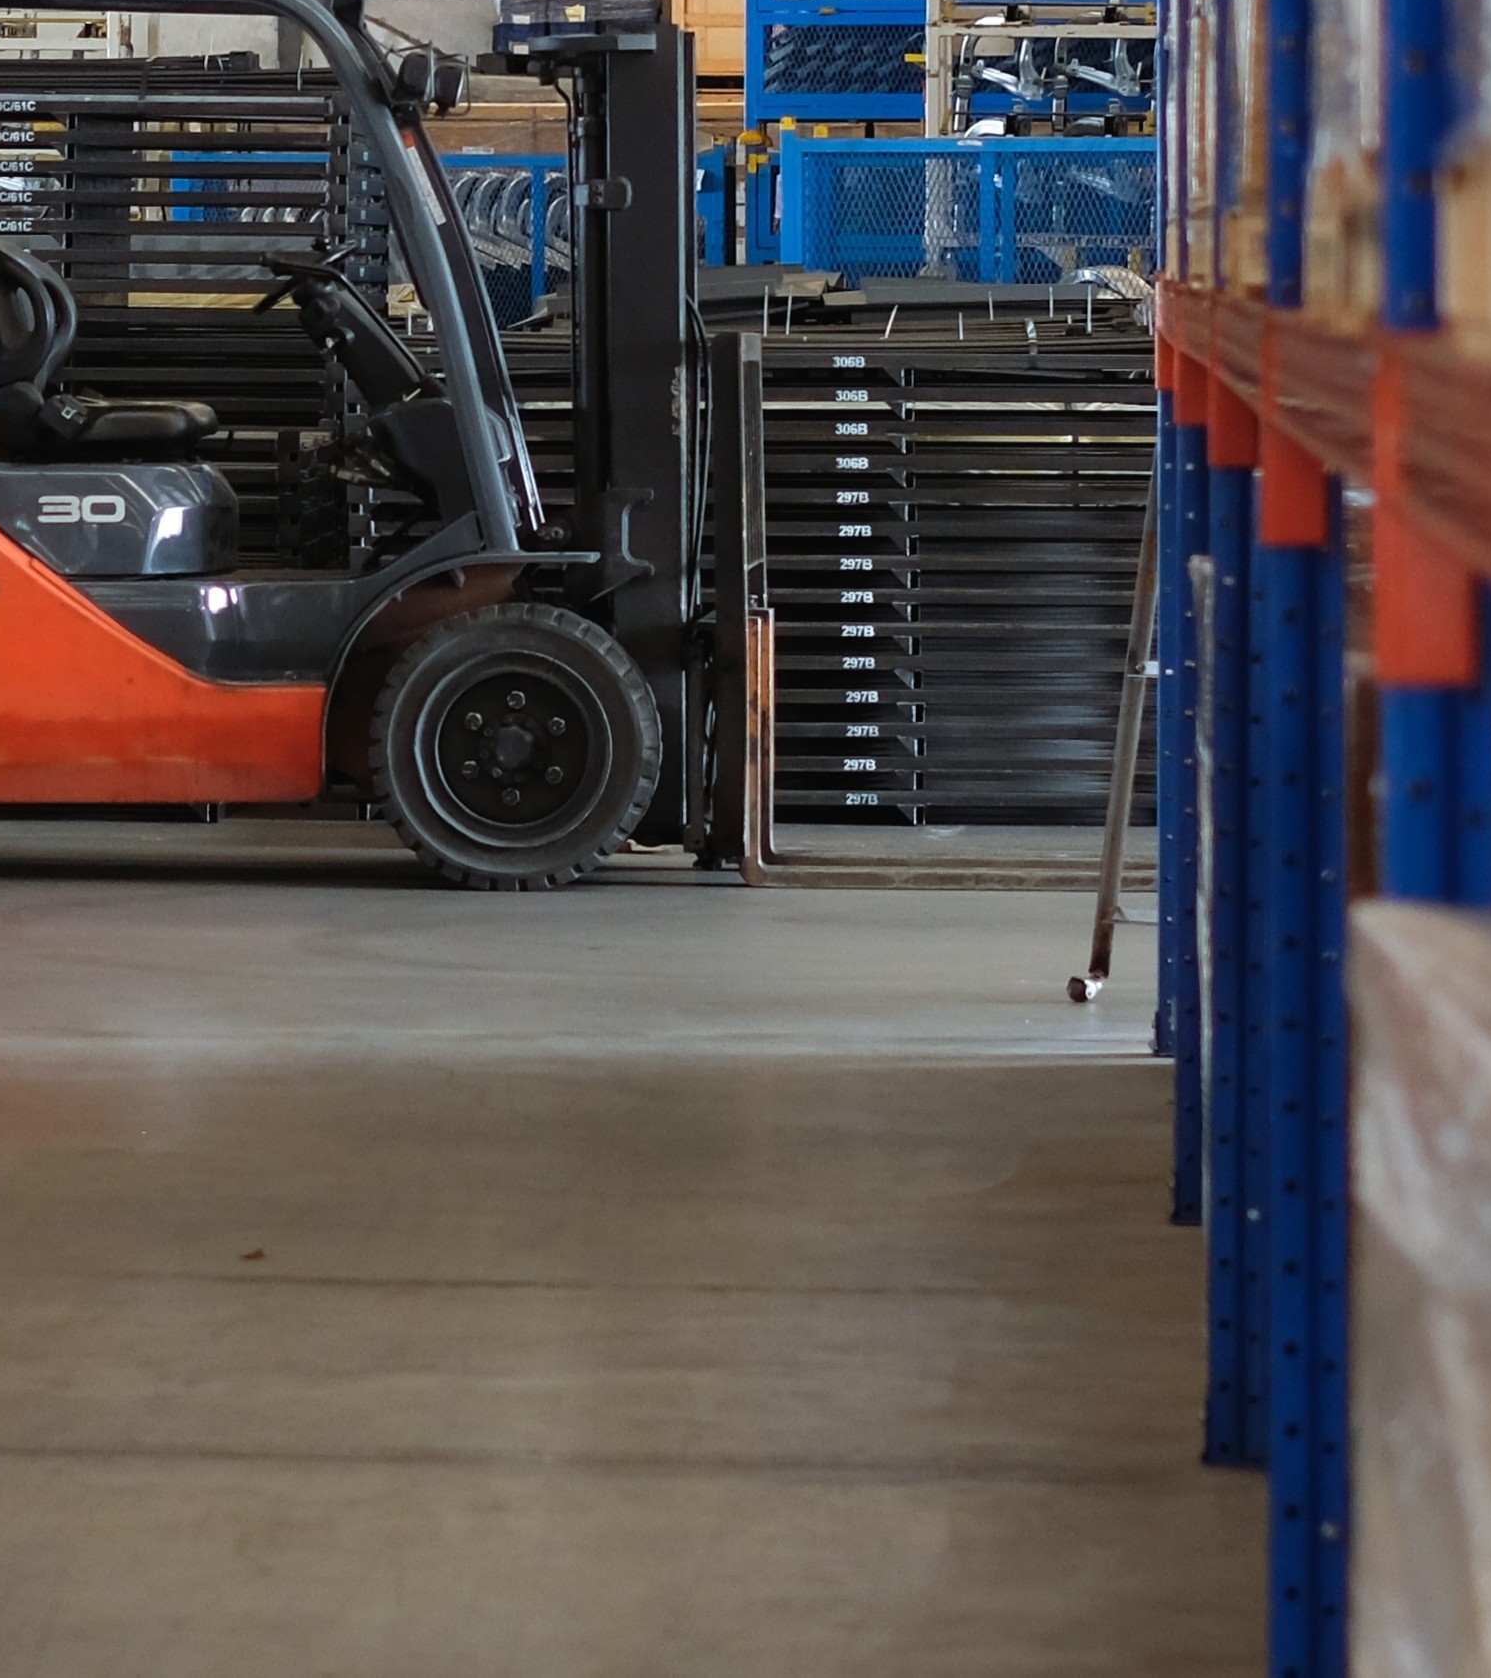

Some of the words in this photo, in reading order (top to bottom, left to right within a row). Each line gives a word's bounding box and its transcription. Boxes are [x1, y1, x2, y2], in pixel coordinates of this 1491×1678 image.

[832, 355, 866, 368] 306B
[835, 389, 869, 402] 306B
[835, 422, 869, 436] 306B
[836, 491, 870, 504] 297B
[37, 495, 126, 523] 30
[838, 524, 872, 537] 297B
[839, 557, 873, 571] 297B
[840, 590, 874, 604] 297B
[841, 624, 876, 638] 297B
[842, 656, 876, 670] 297B
[845, 690, 879, 703] 297B
[845, 725, 880, 737] 297B
[843, 758, 877, 771] 297B
[845, 792, 879, 805] 297B
